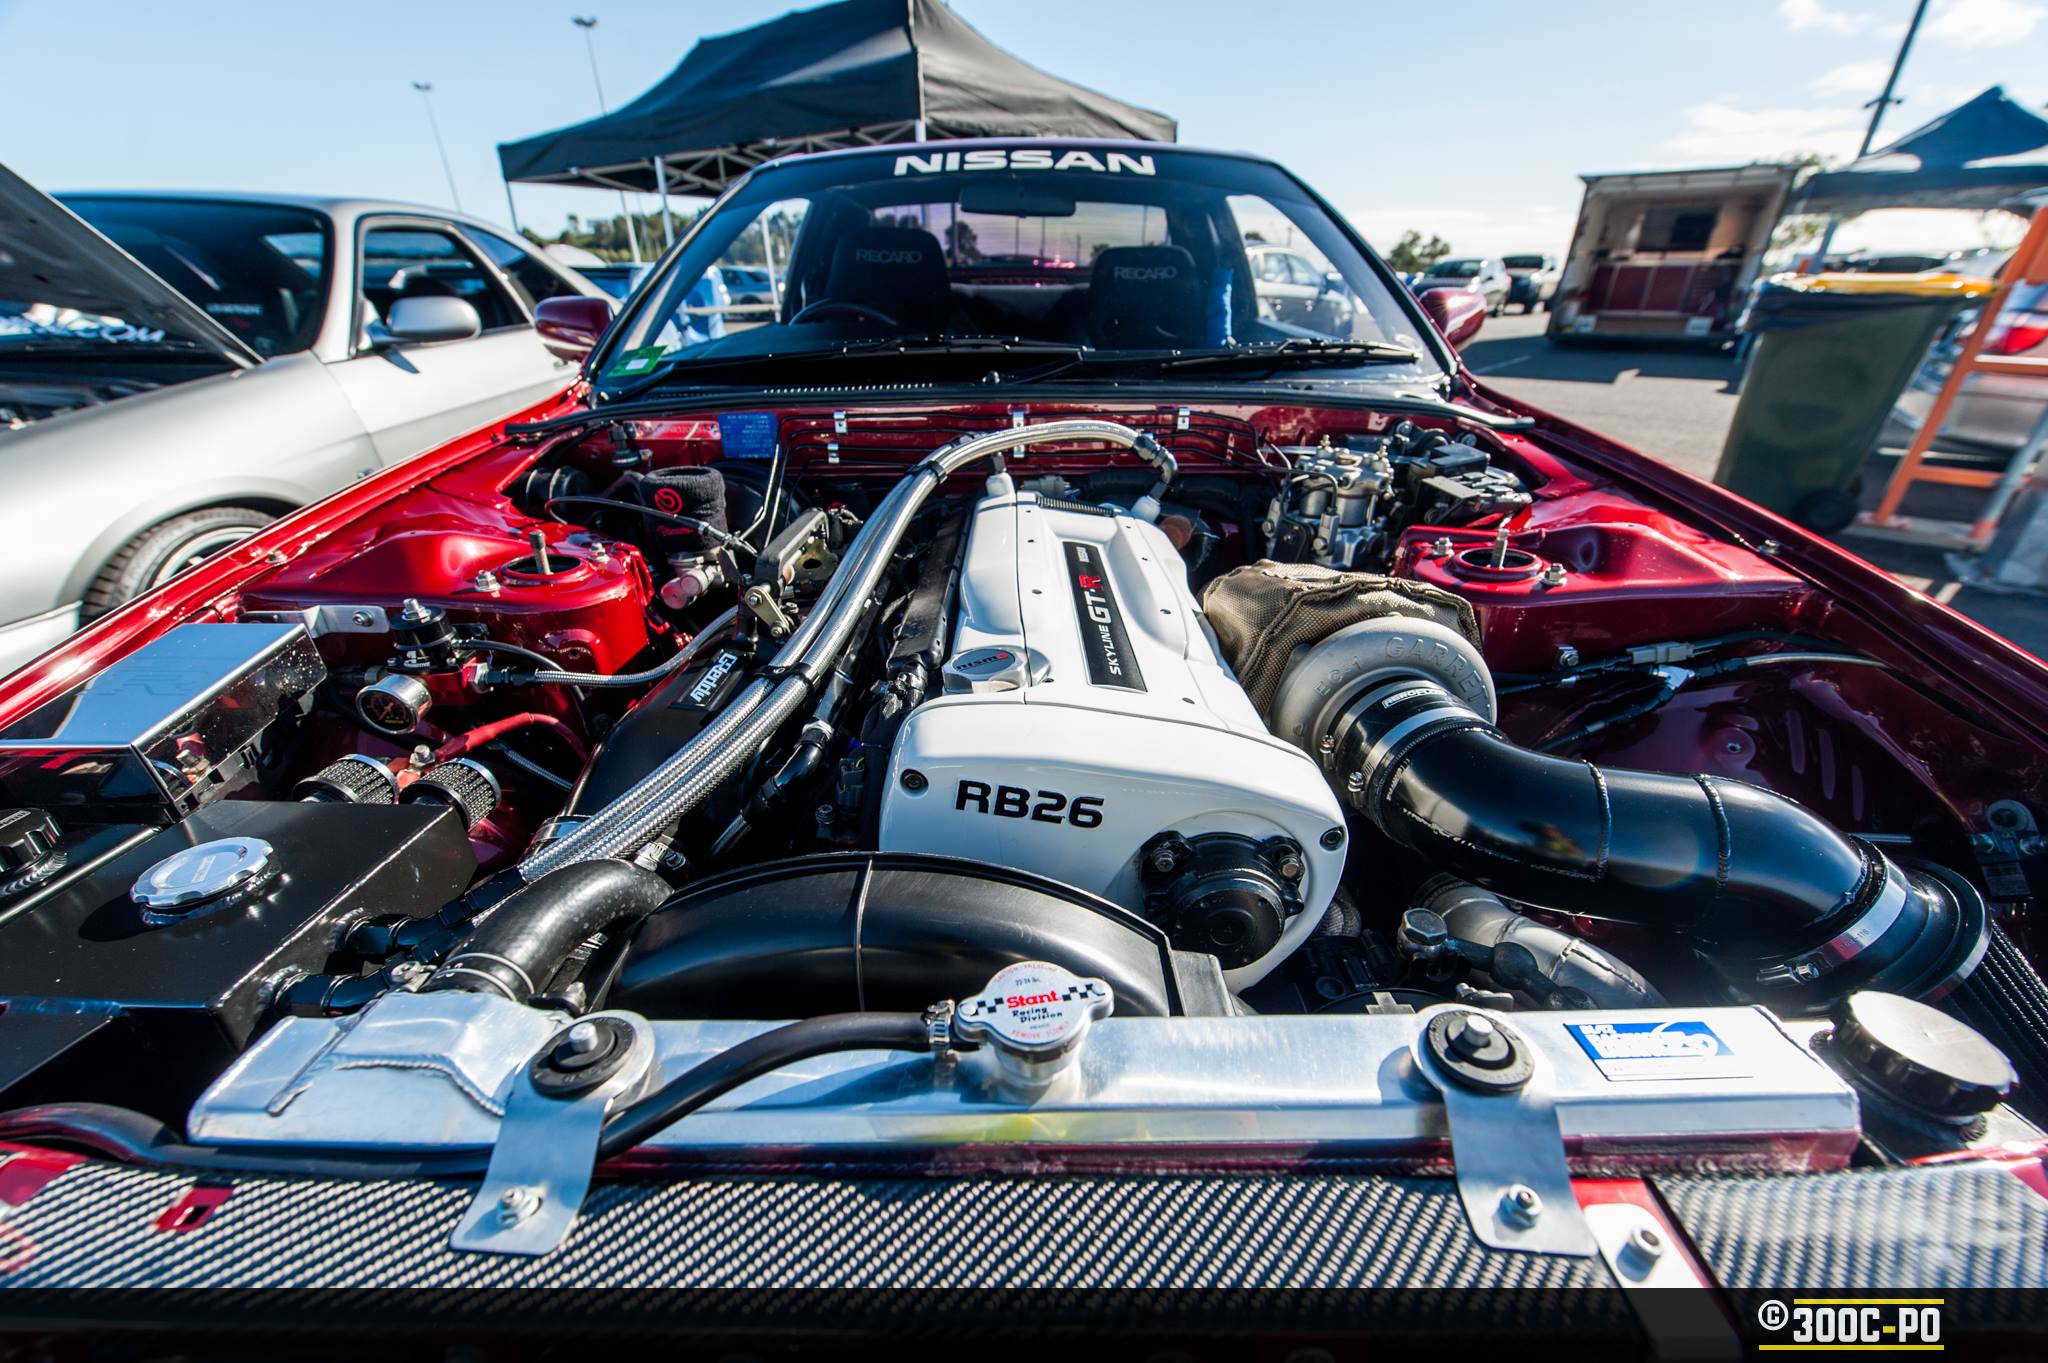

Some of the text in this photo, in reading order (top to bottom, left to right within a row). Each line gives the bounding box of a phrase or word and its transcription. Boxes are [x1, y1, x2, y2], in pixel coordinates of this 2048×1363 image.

[894, 150, 1156, 176] NISSAN
[856, 249, 922, 264] RECARO
[1113, 266, 1177, 280] RECARO
[1098, 624, 1122, 676] SKYLINE
[689, 652, 738, 702] GReddy
[955, 780, 1105, 828] RB26
[1007, 991, 1058, 1008] Stant
[1012, 1007, 1047, 1017] Racing
[1020, 1012, 1063, 1023] Division
